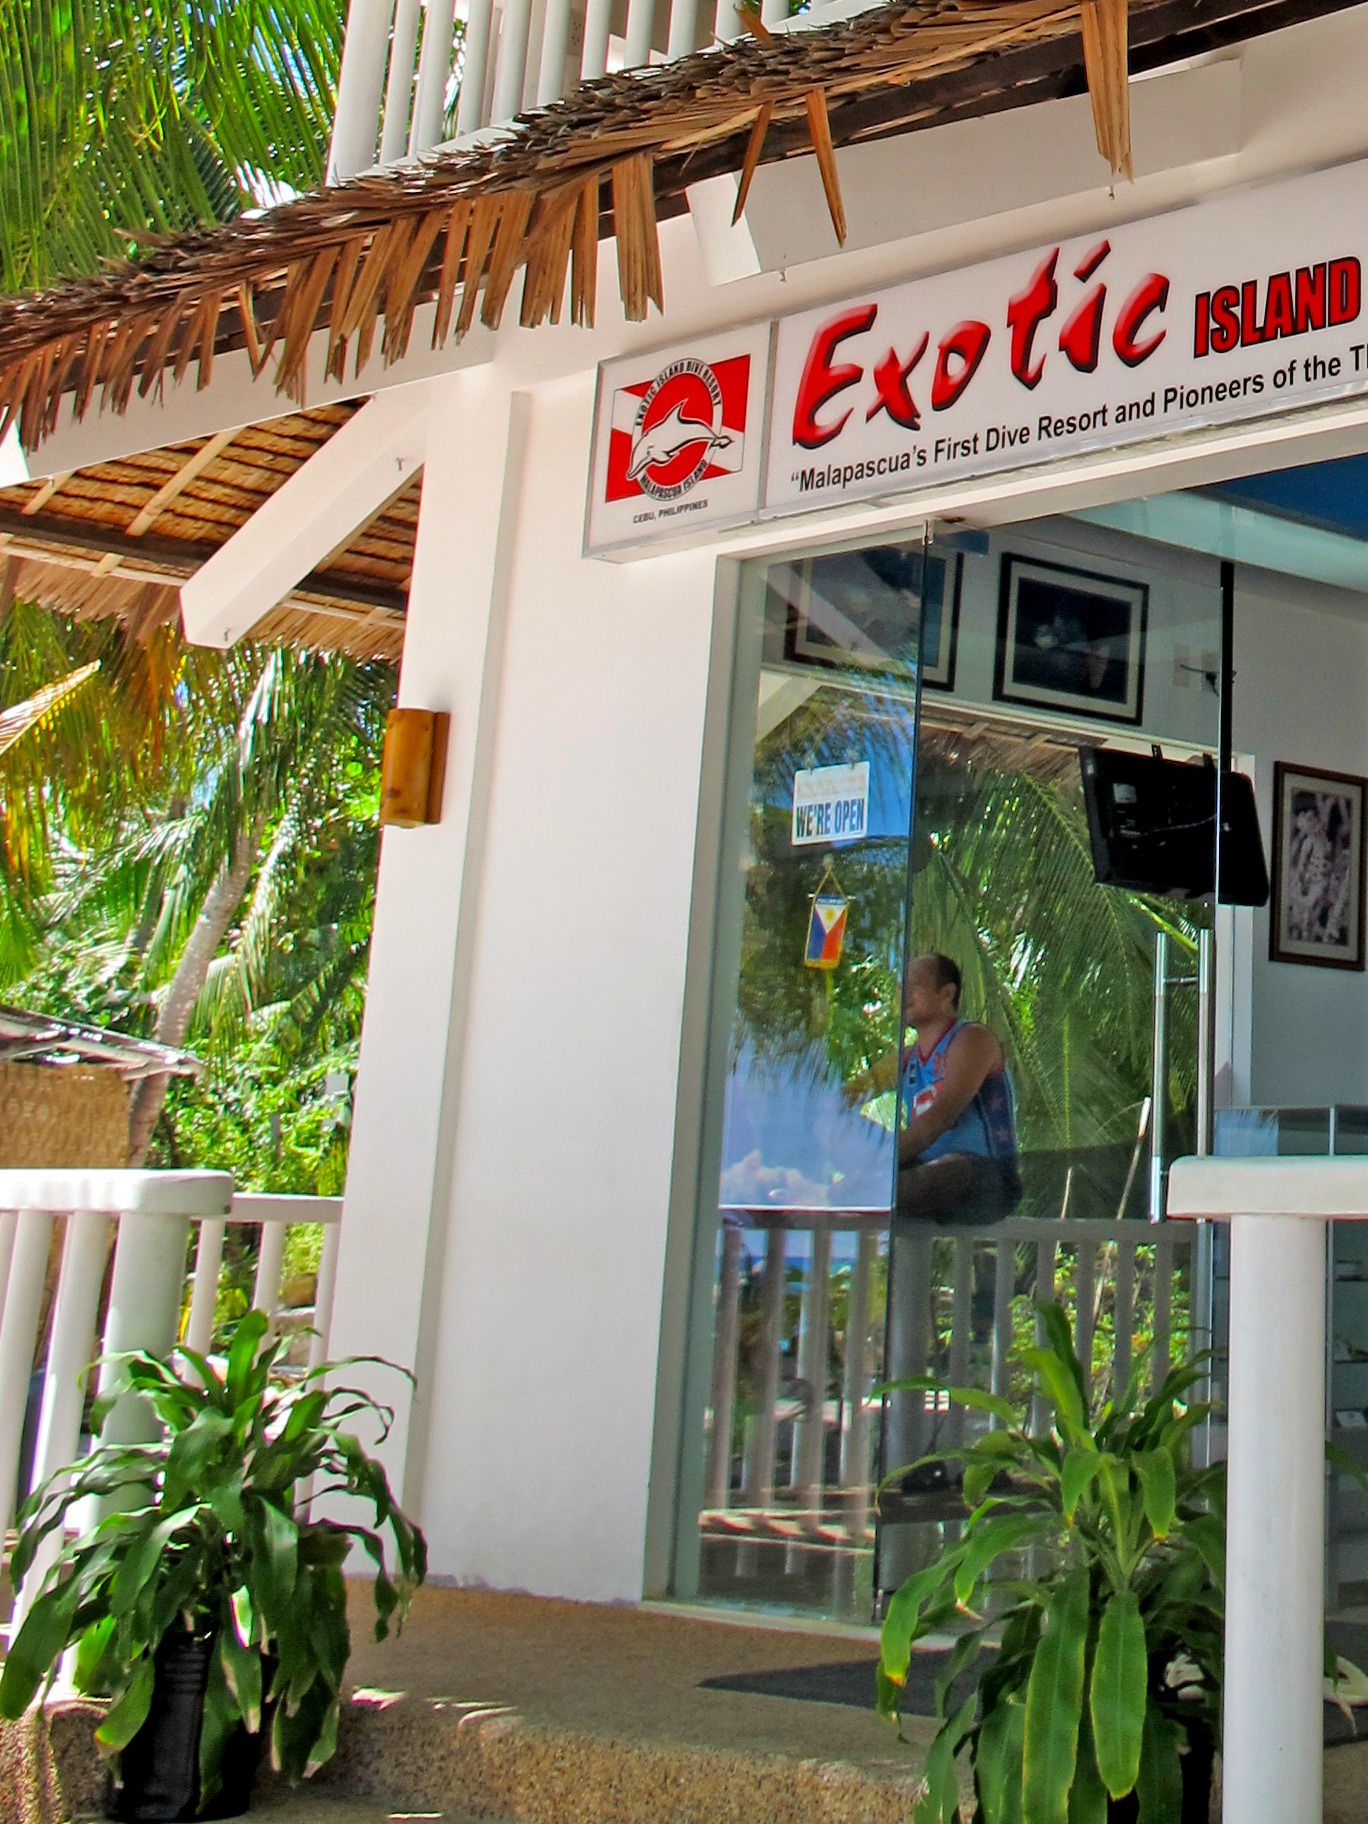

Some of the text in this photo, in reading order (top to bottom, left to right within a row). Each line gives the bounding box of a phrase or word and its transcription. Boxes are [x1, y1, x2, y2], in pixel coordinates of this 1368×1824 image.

[791, 239, 1171, 451] Exotic
[1193, 255, 1362, 359] ISLAND
[934, 431, 979, 463] First
[985, 424, 1031, 451] Dive
[1037, 403, 1109, 441] Resort
[1115, 391, 1156, 424] and
[1163, 372, 1266, 415] Pioneers
[1272, 357, 1298, 389] of
[1303, 352, 1343, 382] the
[658, 499, 709, 519] PHILIPPINES
[834, 798, 865, 834] OPEN
